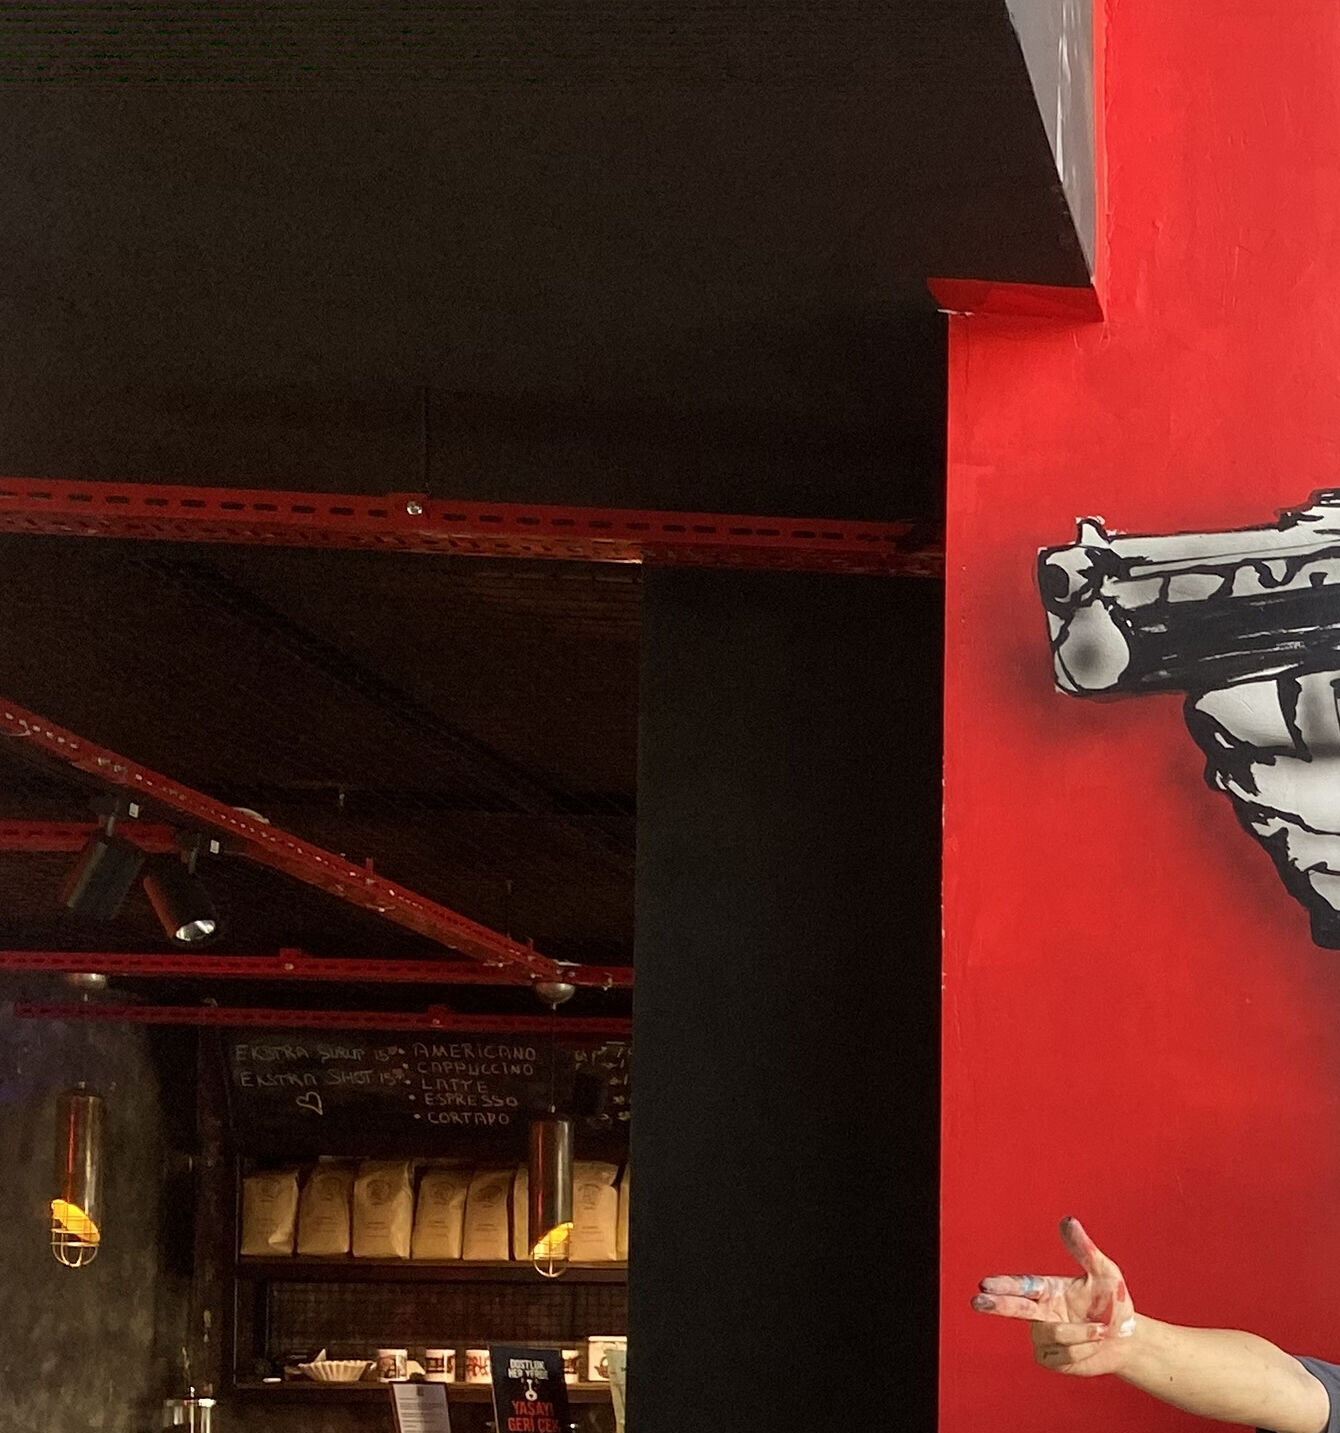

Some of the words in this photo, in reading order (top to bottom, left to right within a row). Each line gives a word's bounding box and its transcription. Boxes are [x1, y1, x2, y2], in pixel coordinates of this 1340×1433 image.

[236, 1044, 309, 1061] EKSTRA
[413, 1042, 537, 1061] AMERICANO
[417, 1061, 534, 1076] CAPPUCCINO
[241, 1071, 318, 1087] EKSTRA
[327, 1068, 373, 1086] SHOT
[421, 1077, 488, 1093] LATTE
[424, 1094, 519, 1108] ESPRESSO
[427, 1111, 510, 1126] CORTADO
